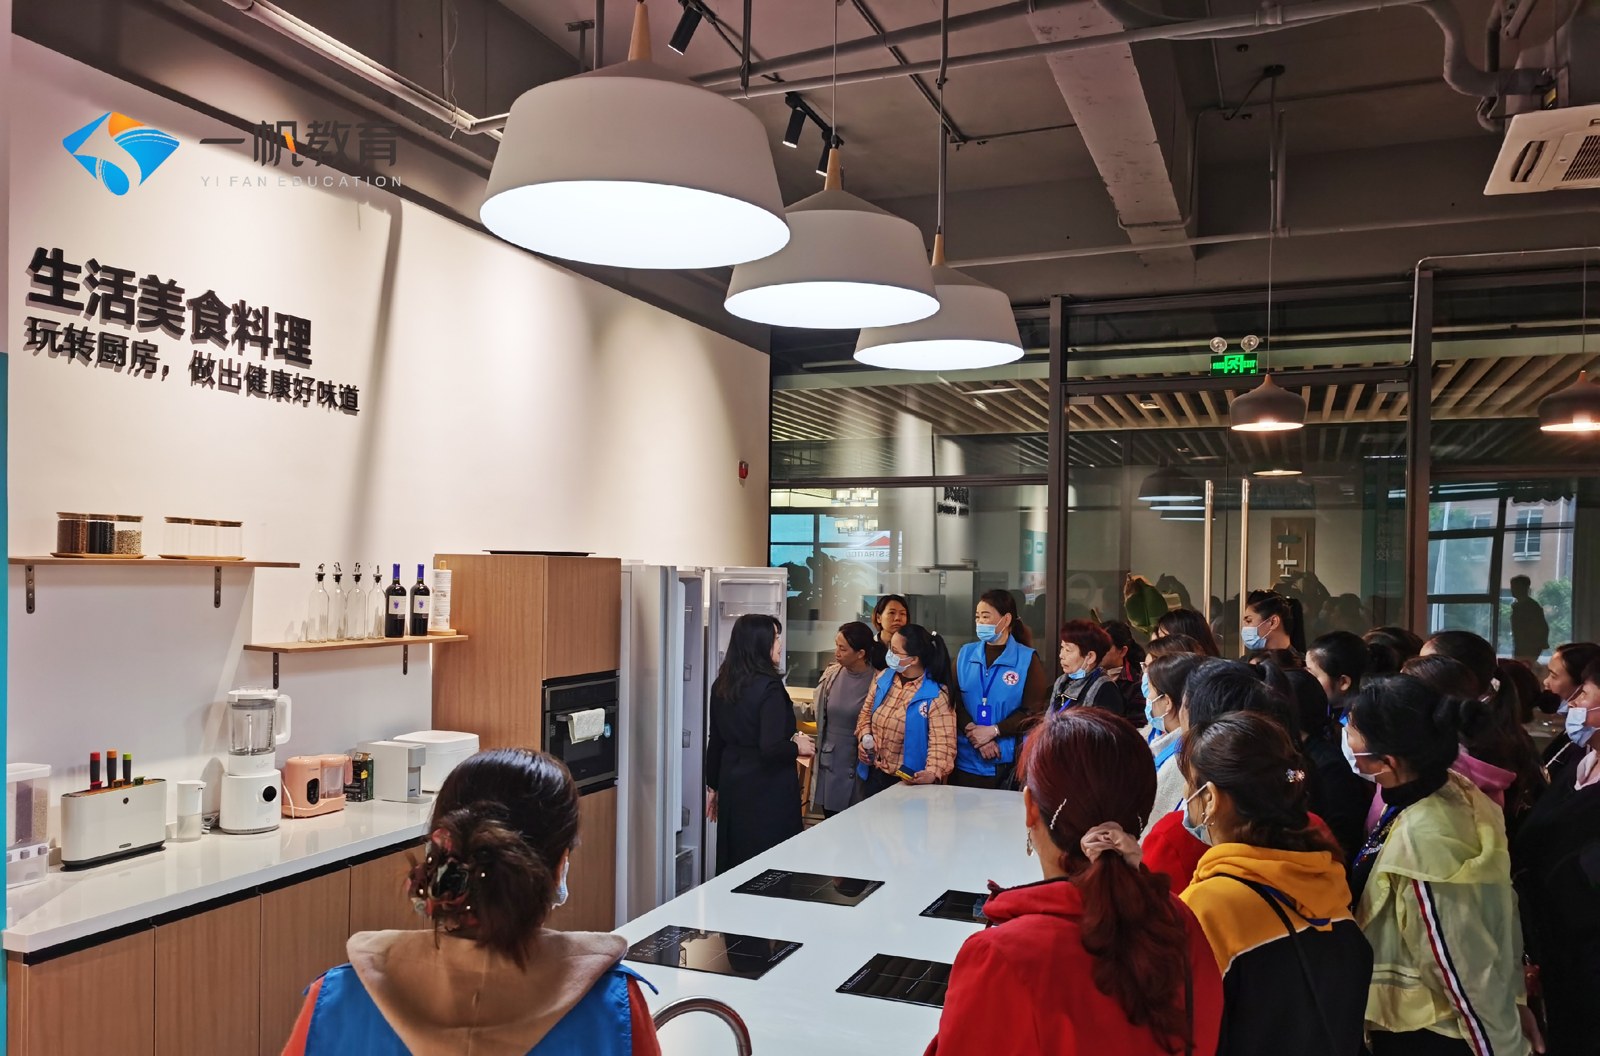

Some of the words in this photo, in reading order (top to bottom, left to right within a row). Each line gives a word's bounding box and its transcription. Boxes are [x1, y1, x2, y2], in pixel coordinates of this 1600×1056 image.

[26, 247, 313, 369] 生活美食料理
